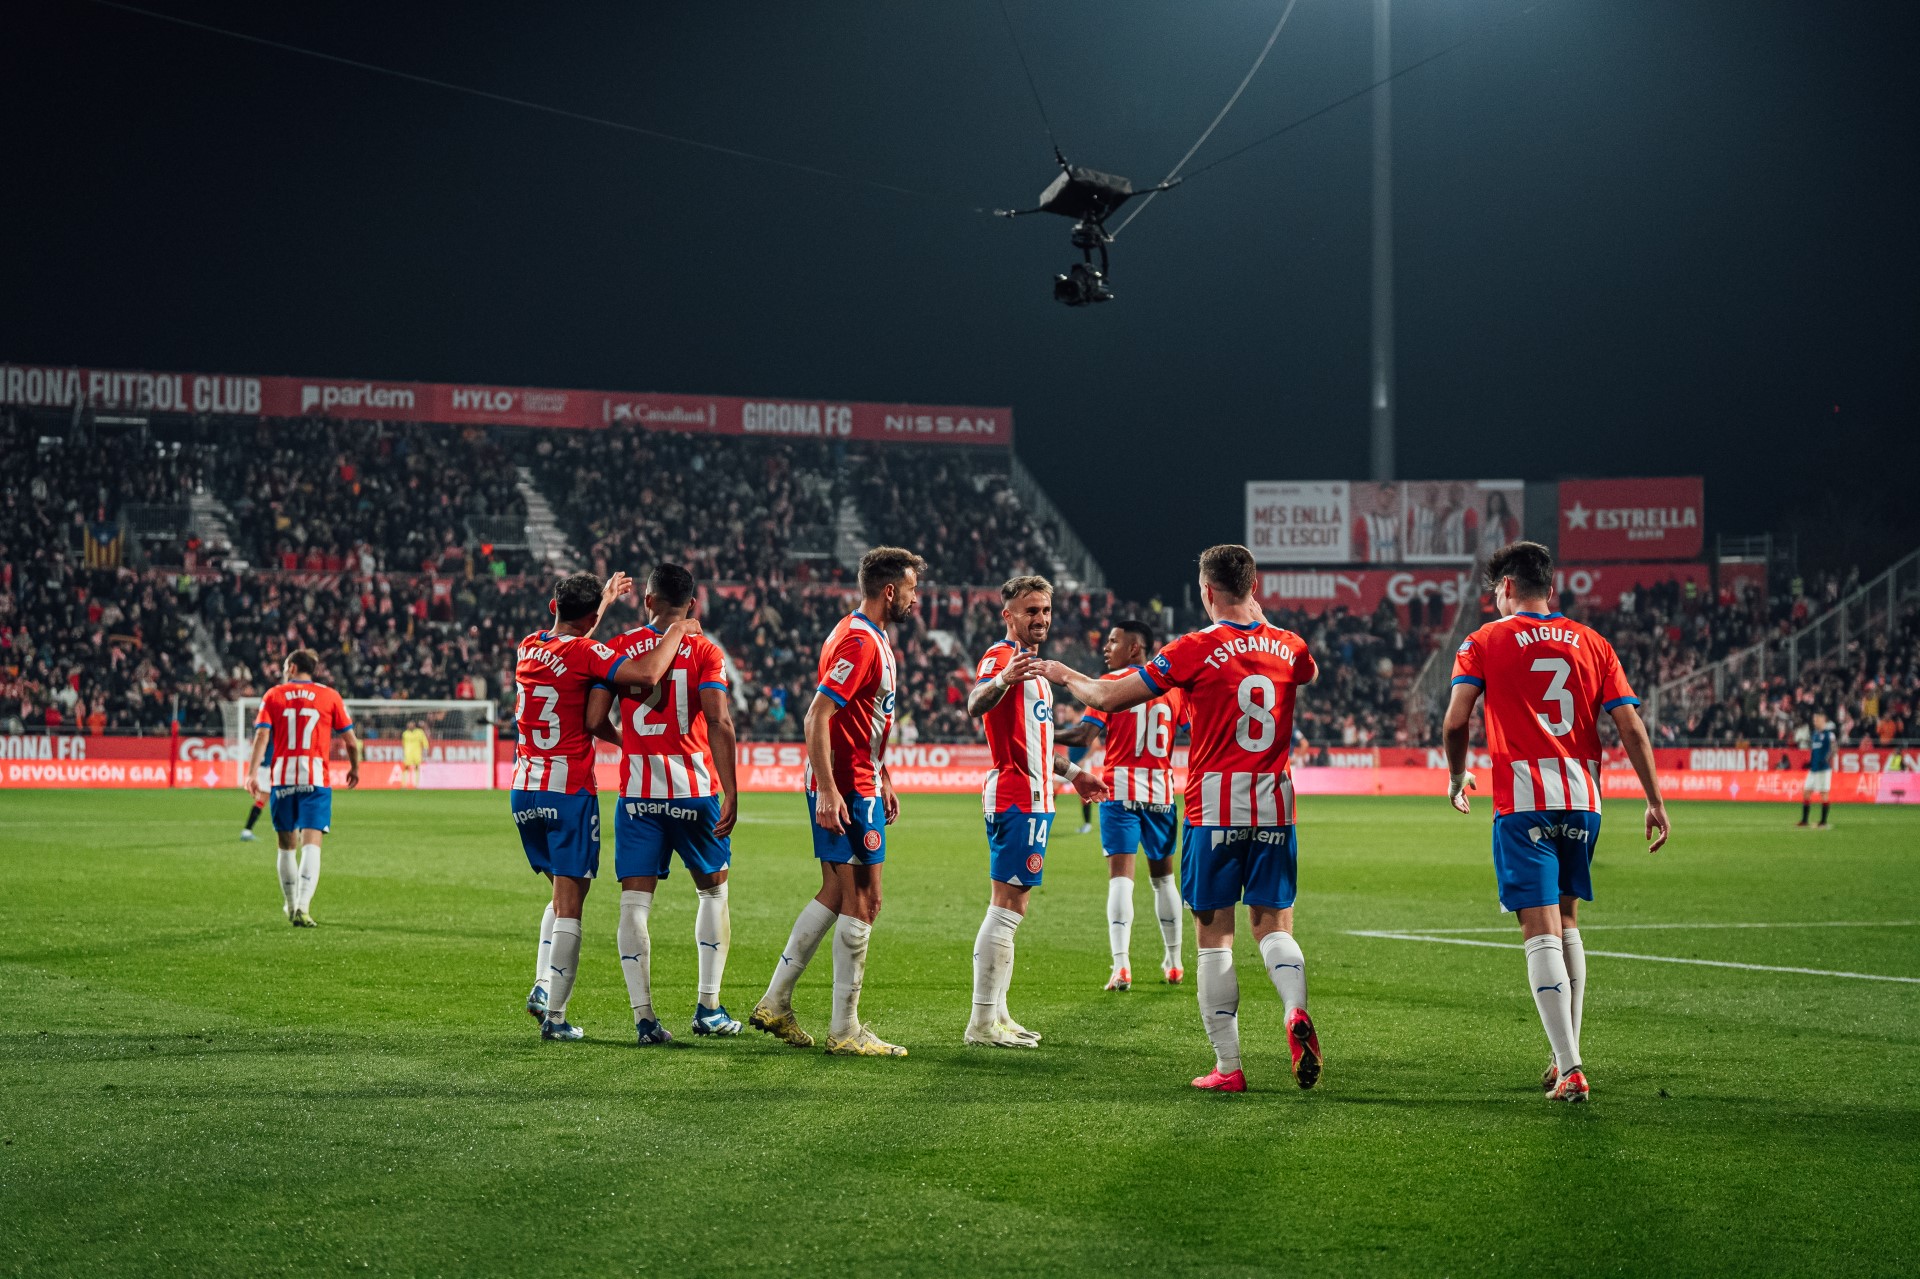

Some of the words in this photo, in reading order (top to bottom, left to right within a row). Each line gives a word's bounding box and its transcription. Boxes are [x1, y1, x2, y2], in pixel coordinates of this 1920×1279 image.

[194, 377, 261, 414] CLUB
[323, 386, 414, 409] parlem
[452, 390, 513, 412] HYLO
[743, 402, 822, 433] GIRONA
[824, 404, 851, 434] FC
[885, 415, 994, 433] NISSAN
[1596, 508, 1697, 528] ESTRELLA
[1254, 527, 1271, 546] DE
[1263, 574, 1336, 598] PUMA
[625, 637, 692, 660] HERA
[1515, 626, 1581, 649] MIGUEL
[1204, 636, 1297, 670] TSYGANKOV
[630, 668, 689, 737] 21
[1530, 657, 1575, 737] 3
[1236, 674, 1276, 752] 8
[282, 708, 320, 750] 17
[1130, 703, 1172, 758] 16
[1690, 749, 1746, 771] GIRONA
[1750, 749, 1769, 771] FC
[10, 764, 125, 782] DEVOLUCIÓN
[636, 801, 698, 821] parlem
[863, 796, 876, 824] 7
[1028, 818, 1047, 847] 14
